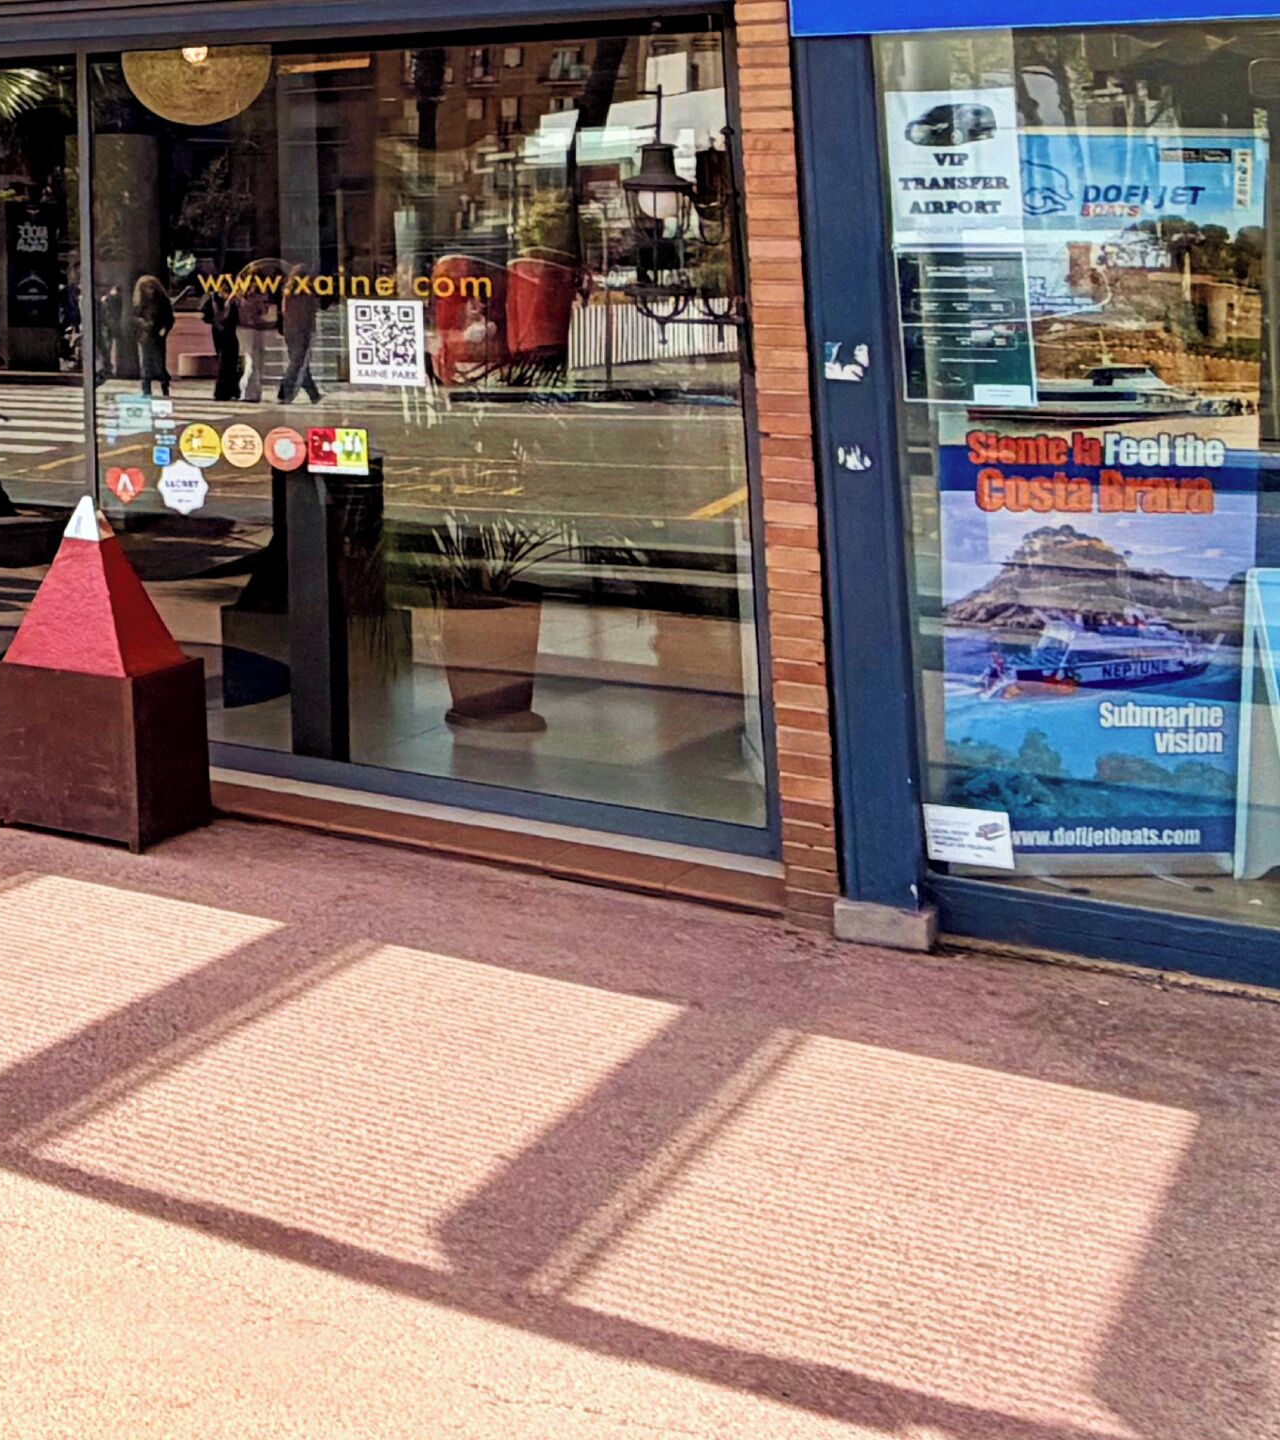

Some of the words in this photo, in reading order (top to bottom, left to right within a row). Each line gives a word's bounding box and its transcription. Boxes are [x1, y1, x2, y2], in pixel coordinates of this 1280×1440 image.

[933, 153, 969, 167] VIP
[899, 176, 1010, 191] TRANSFER
[909, 200, 1001, 214] AIRPORT
[197, 266, 493, 298] www.xaine.com
[357, 368, 388, 378] XAINE
[392, 370, 419, 380] PARK
[966, 429, 1068, 466] Siente
[1072, 431, 1101, 467] la
[1104, 431, 1171, 468] Feel
[1173, 433, 1226, 468] the
[975, 467, 1093, 513] Costa
[1098, 468, 1215, 514] Brava
[1100, 701, 1224, 728] Submarine
[1154, 728, 1224, 754] vision
